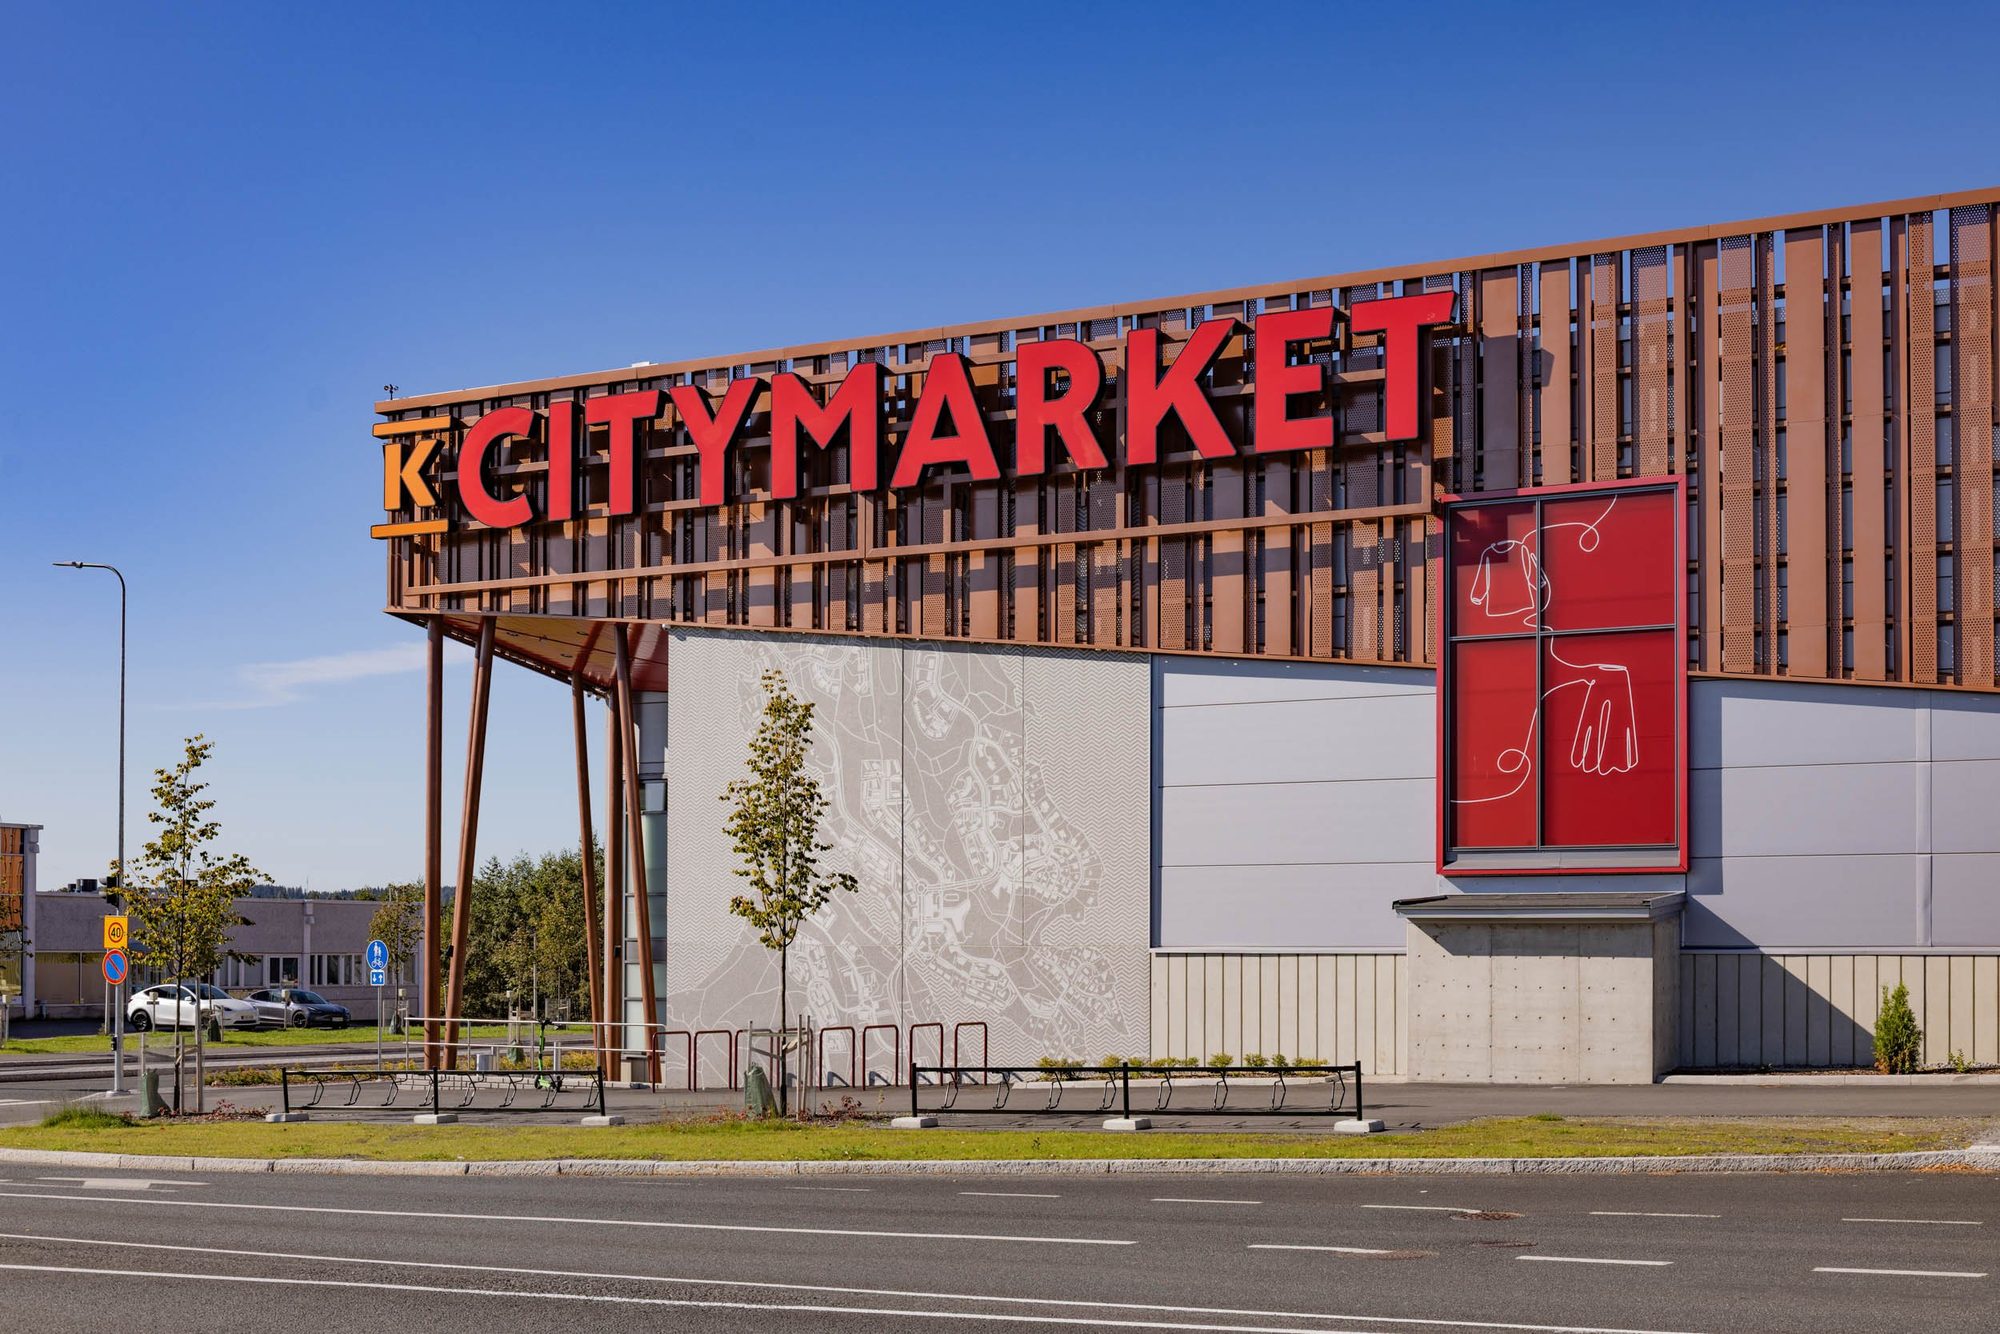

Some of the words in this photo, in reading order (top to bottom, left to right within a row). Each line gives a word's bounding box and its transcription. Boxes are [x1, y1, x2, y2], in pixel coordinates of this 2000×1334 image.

[383, 439, 444, 511] K
[456, 291, 1459, 529] CITYMARKET
[111, 927, 121, 938] 40
